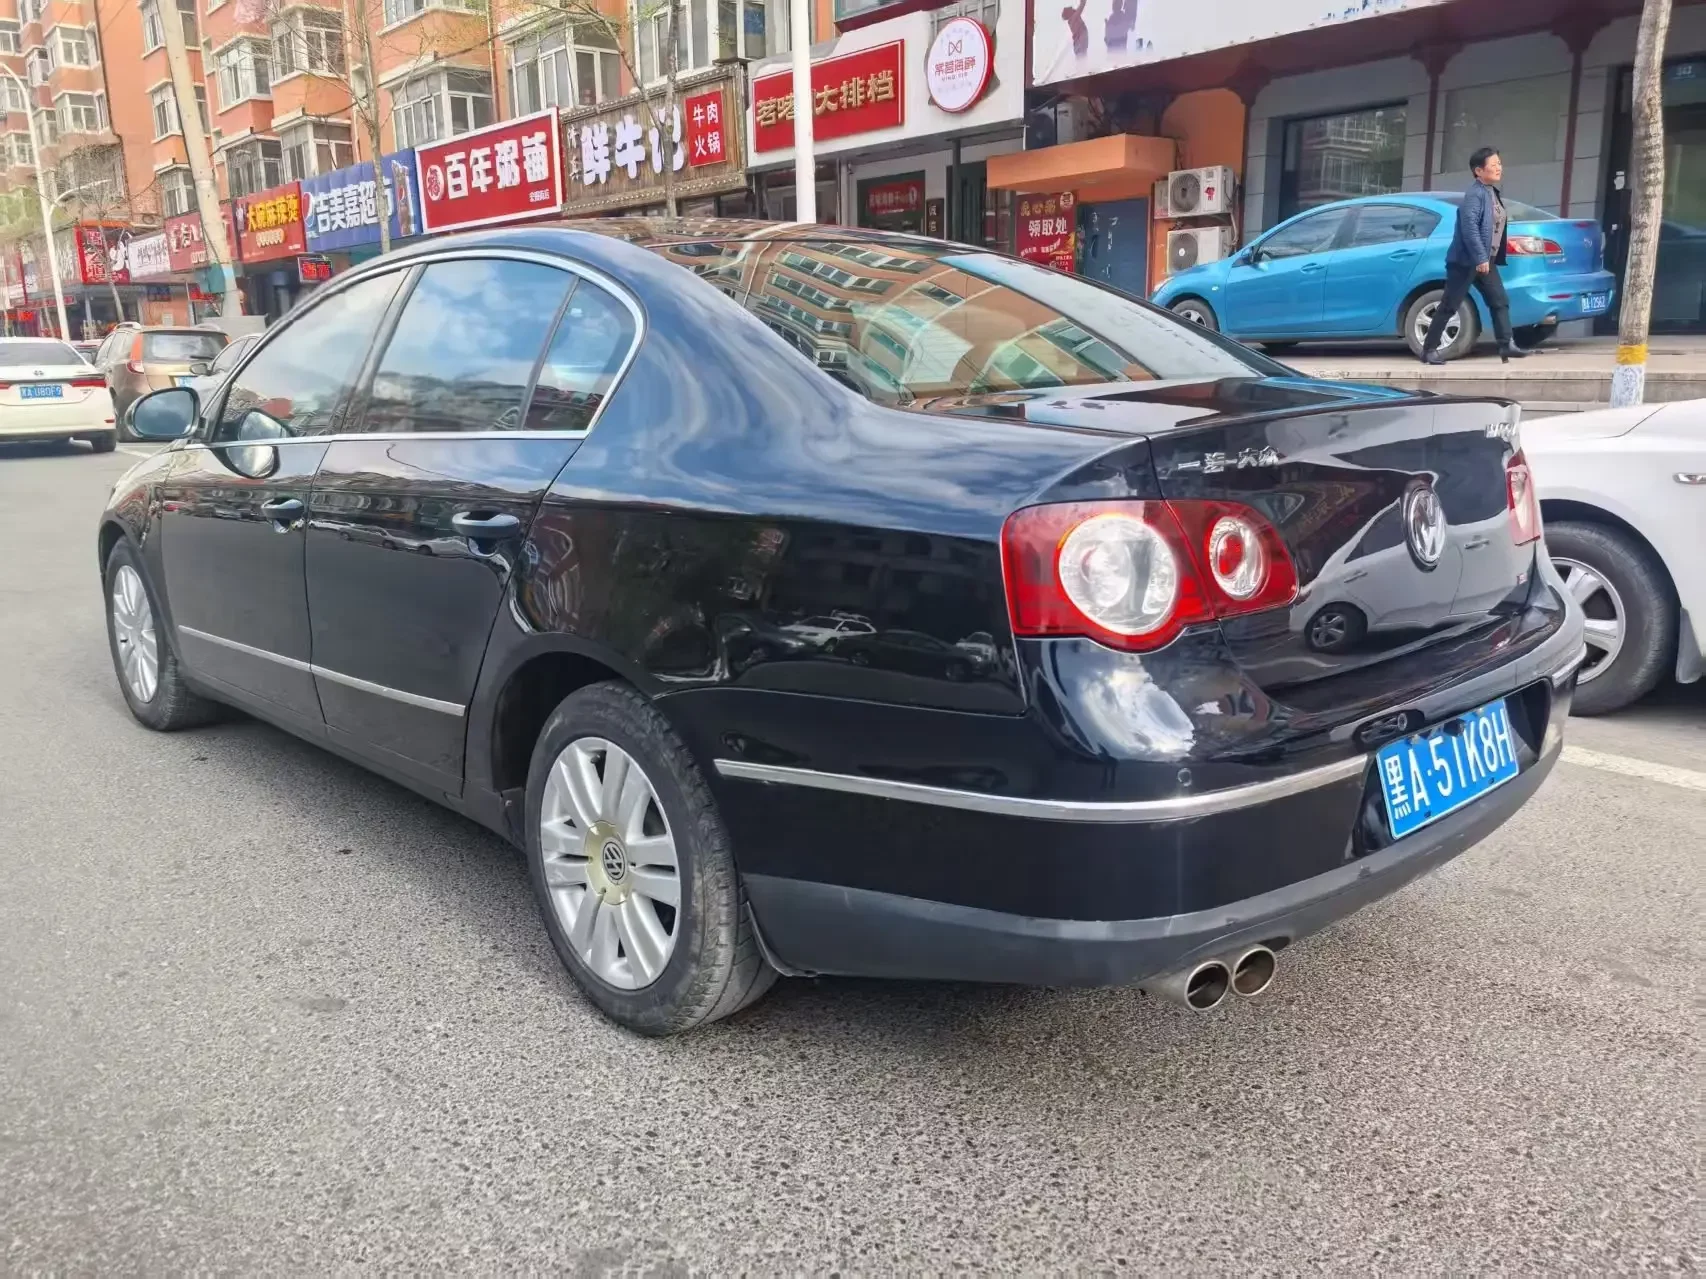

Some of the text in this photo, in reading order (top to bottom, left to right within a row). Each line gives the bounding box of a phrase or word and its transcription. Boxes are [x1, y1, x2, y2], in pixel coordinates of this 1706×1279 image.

[692, 101, 719, 128] 牛肉
[694, 131, 721, 158] 火锅
[1028, 217, 1068, 237] 领取处
